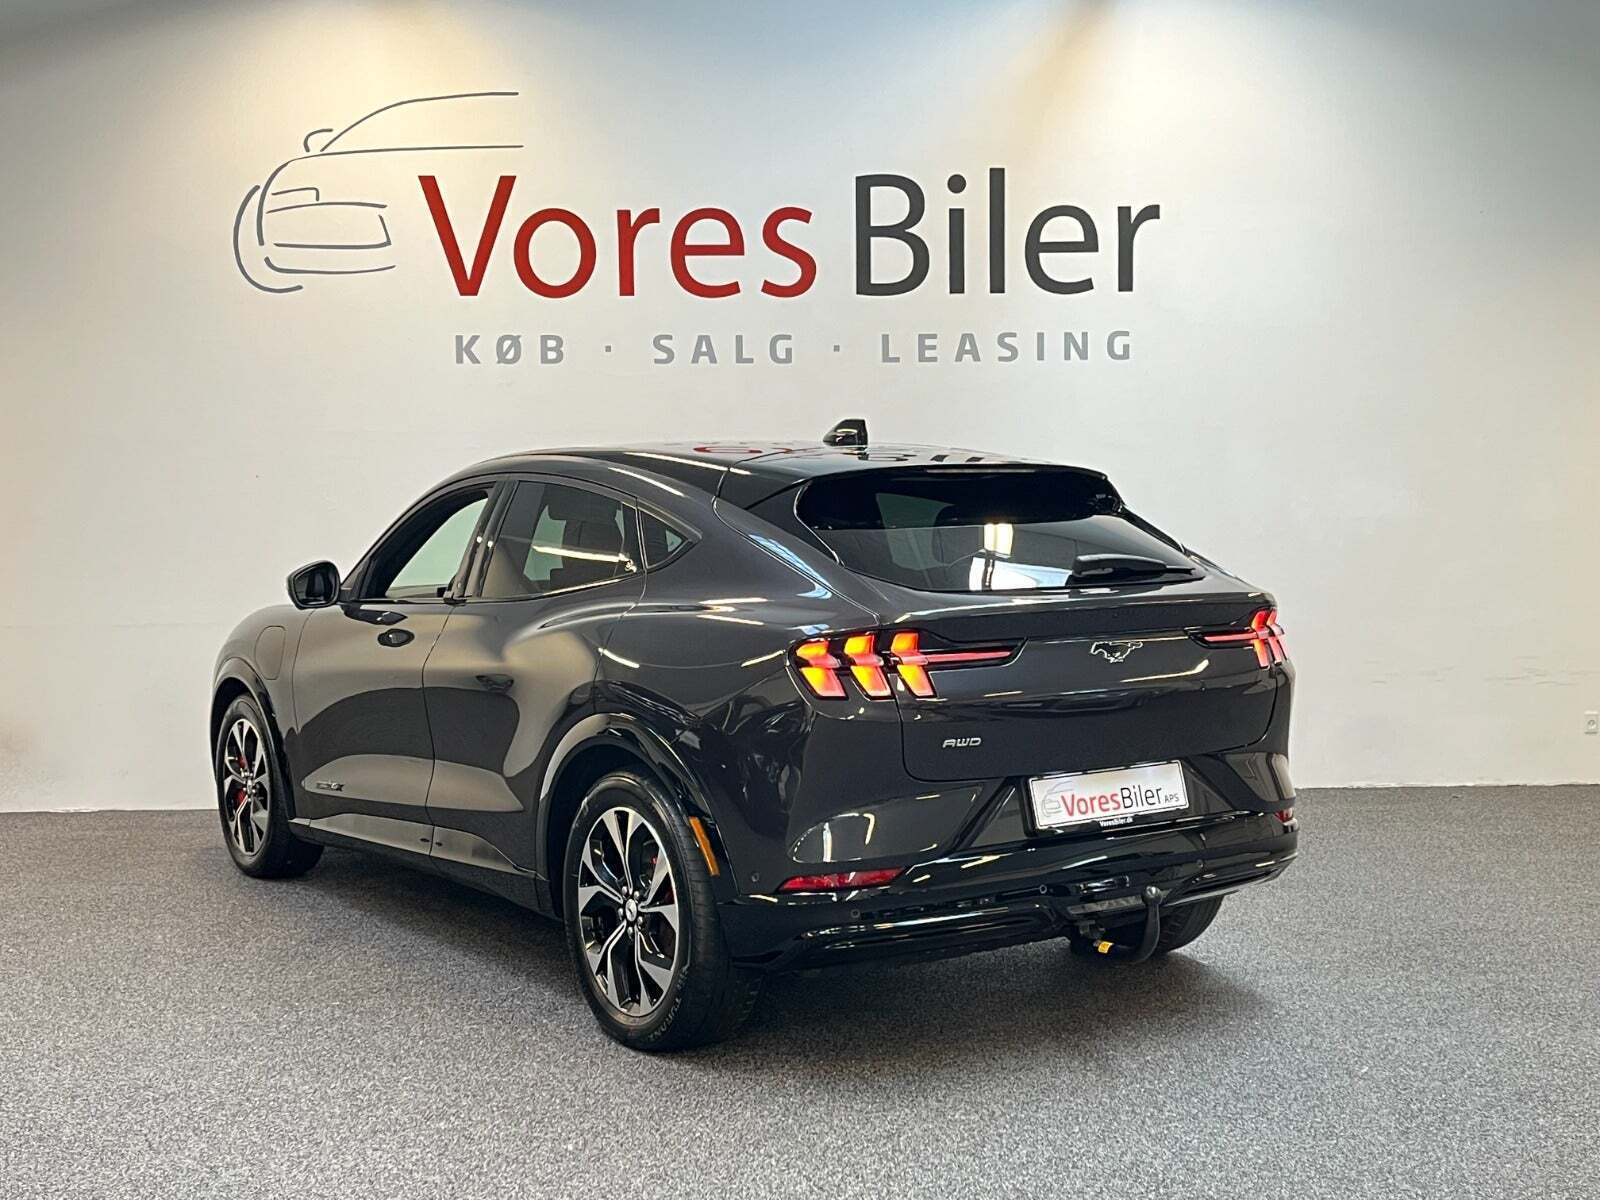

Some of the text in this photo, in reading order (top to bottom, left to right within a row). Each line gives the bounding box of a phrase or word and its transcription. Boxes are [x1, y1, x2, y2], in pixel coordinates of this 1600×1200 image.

[418, 166, 1161, 299] Vores Biler
[455, 330, 1132, 365] KØB SALG LEASING
[942, 737, 981, 748] AWD
